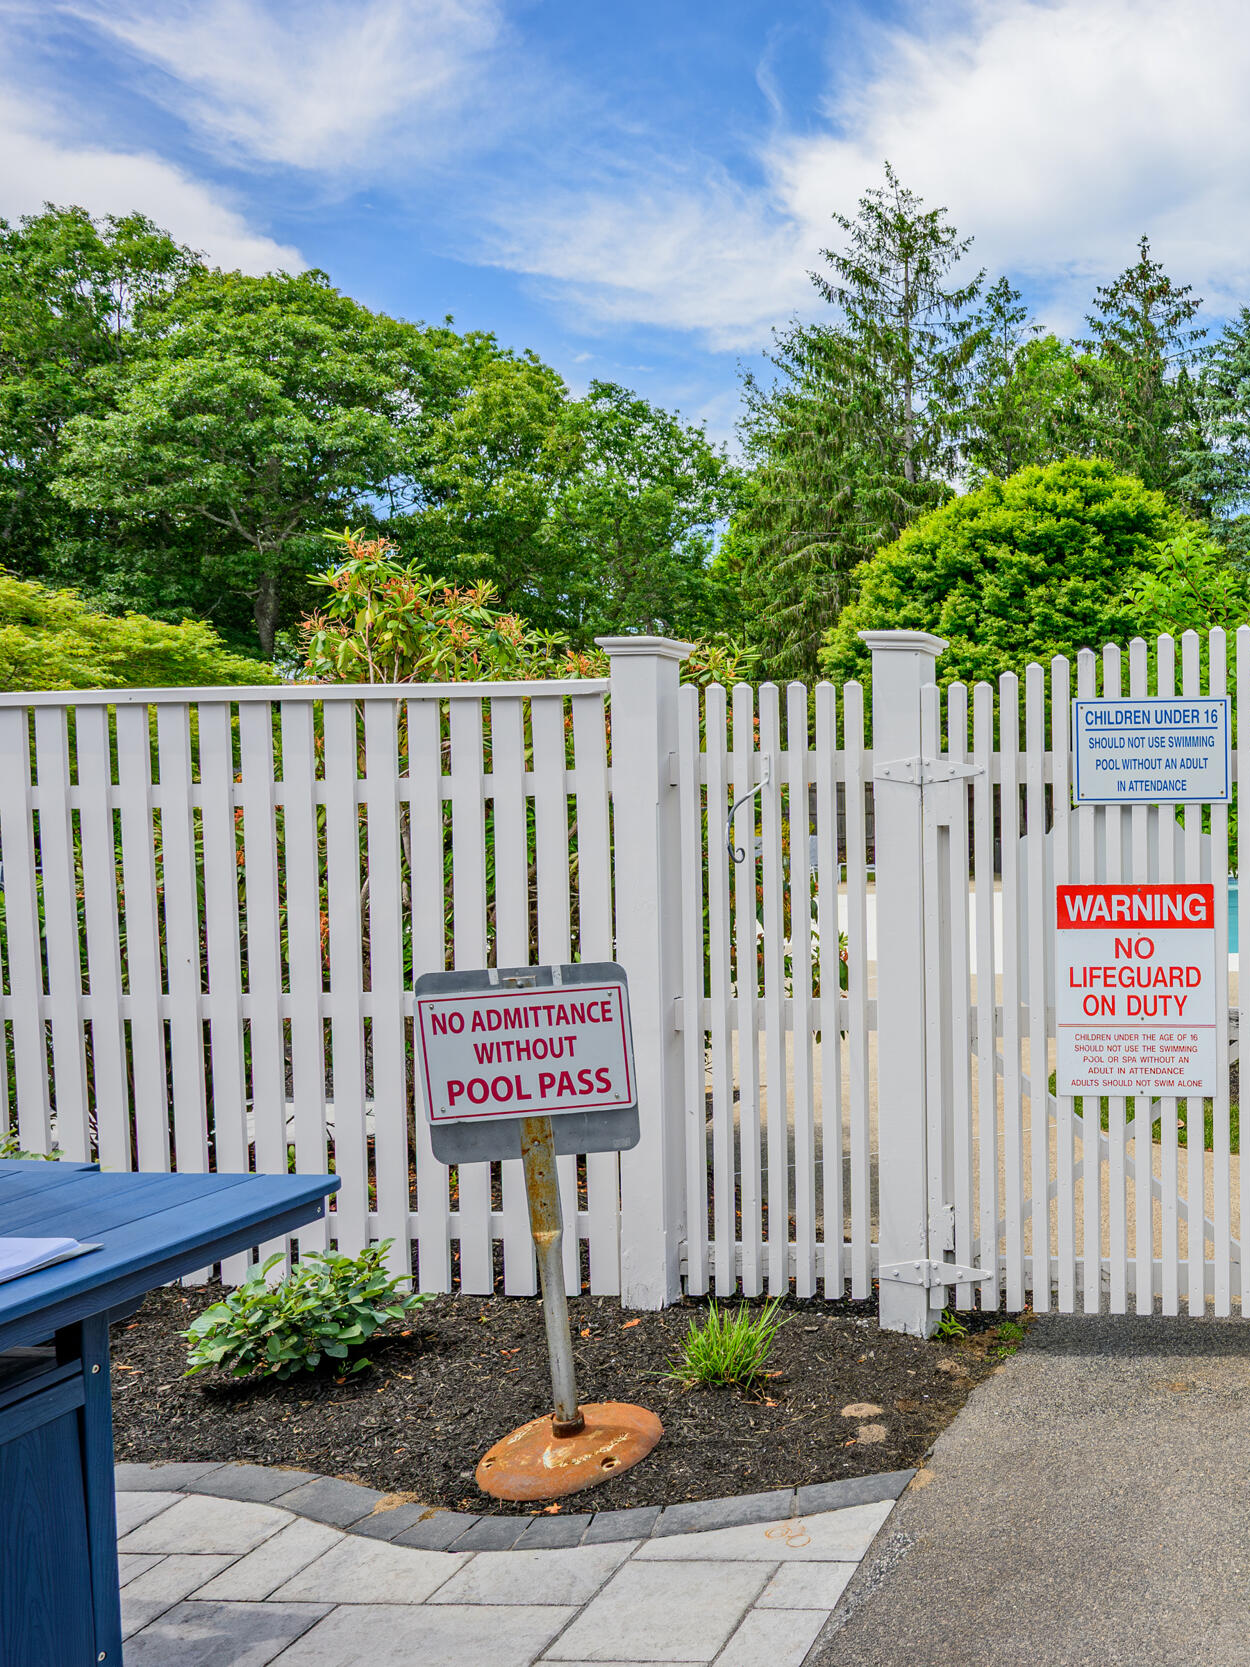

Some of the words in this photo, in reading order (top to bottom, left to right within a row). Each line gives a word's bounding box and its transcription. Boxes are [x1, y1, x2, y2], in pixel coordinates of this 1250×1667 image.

[1085, 710, 1150, 725] CHILDREN
[1155, 709, 1200, 724] UNDER
[1204, 709, 1218, 723] 16
[1089, 737, 1125, 749] SHOULD
[1128, 737, 1145, 748] NOT
[1148, 737, 1165, 748] USE
[1168, 736, 1215, 747] SWIMMING
[1096, 759, 1120, 770] POOL
[1122, 758, 1162, 770] WITHOUT
[1165, 758, 1177, 769] AN
[1180, 758, 1208, 769] ADULT
[1118, 781, 1125, 791] IN
[1128, 780, 1187, 791] ATTENDANCE
[1064, 893, 1207, 922] WARNING
[1115, 937, 1154, 959] NO
[1069, 966, 1202, 988] LIFEGUARD
[1083, 995, 1115, 1016] ON
[1128, 995, 1187, 1016] DUTY
[431, 1012, 465, 1035] NO
[471, 1001, 613, 1032] ADMITTANCE
[473, 1036, 577, 1064] WITHOUT
[447, 1074, 532, 1106] POOL
[538, 1068, 612, 1098] PASS
